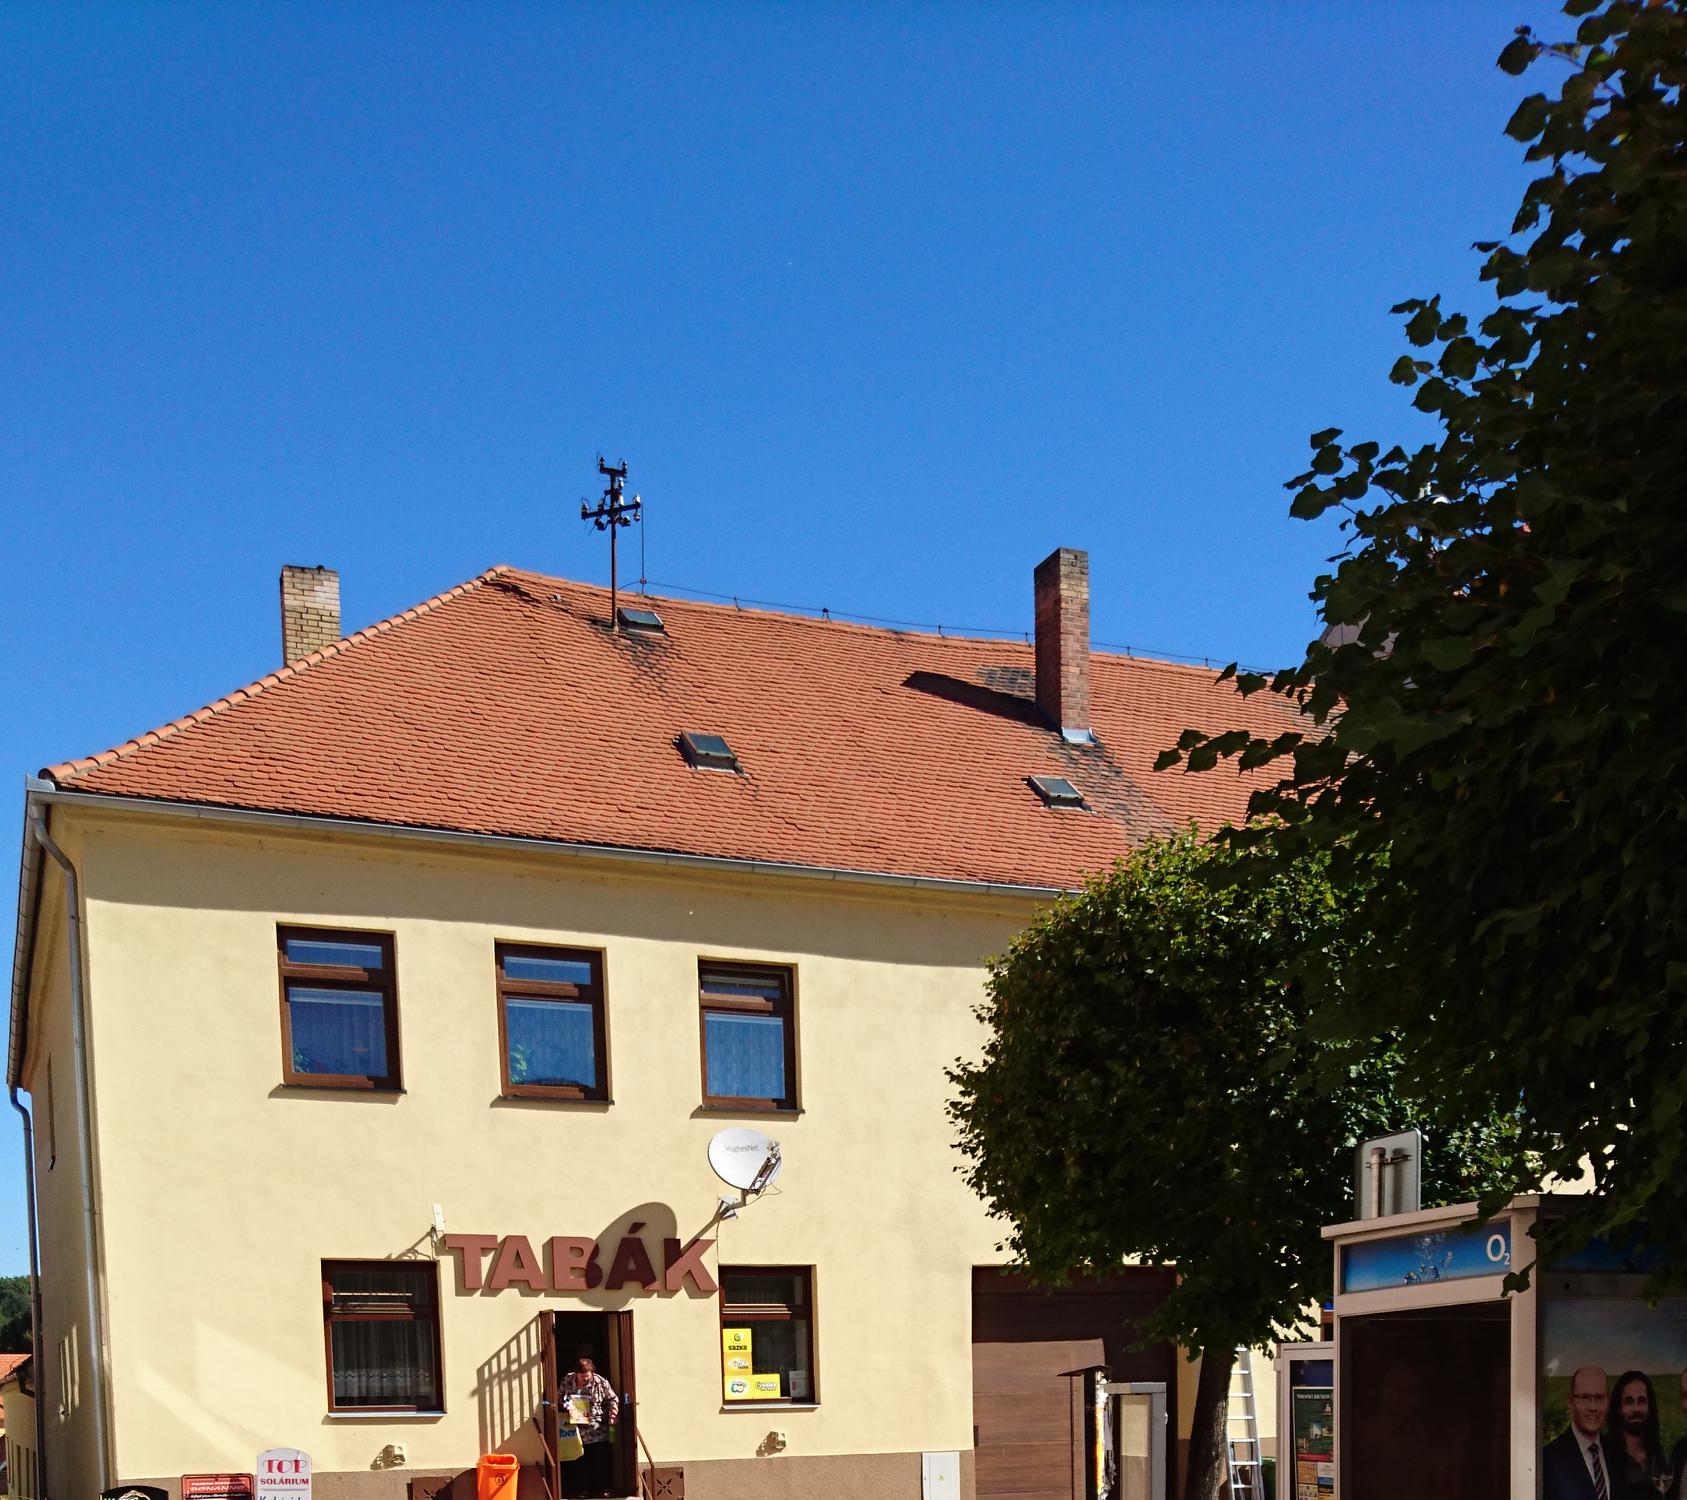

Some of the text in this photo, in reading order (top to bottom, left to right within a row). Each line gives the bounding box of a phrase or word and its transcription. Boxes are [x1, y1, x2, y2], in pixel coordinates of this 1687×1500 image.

[445, 1223, 718, 1292] TABÁK
[1486, 1234, 1511, 1265] O2
[262, 1459, 307, 1474] TOP
[260, 1476, 309, 1486] SOLÁRIUM
